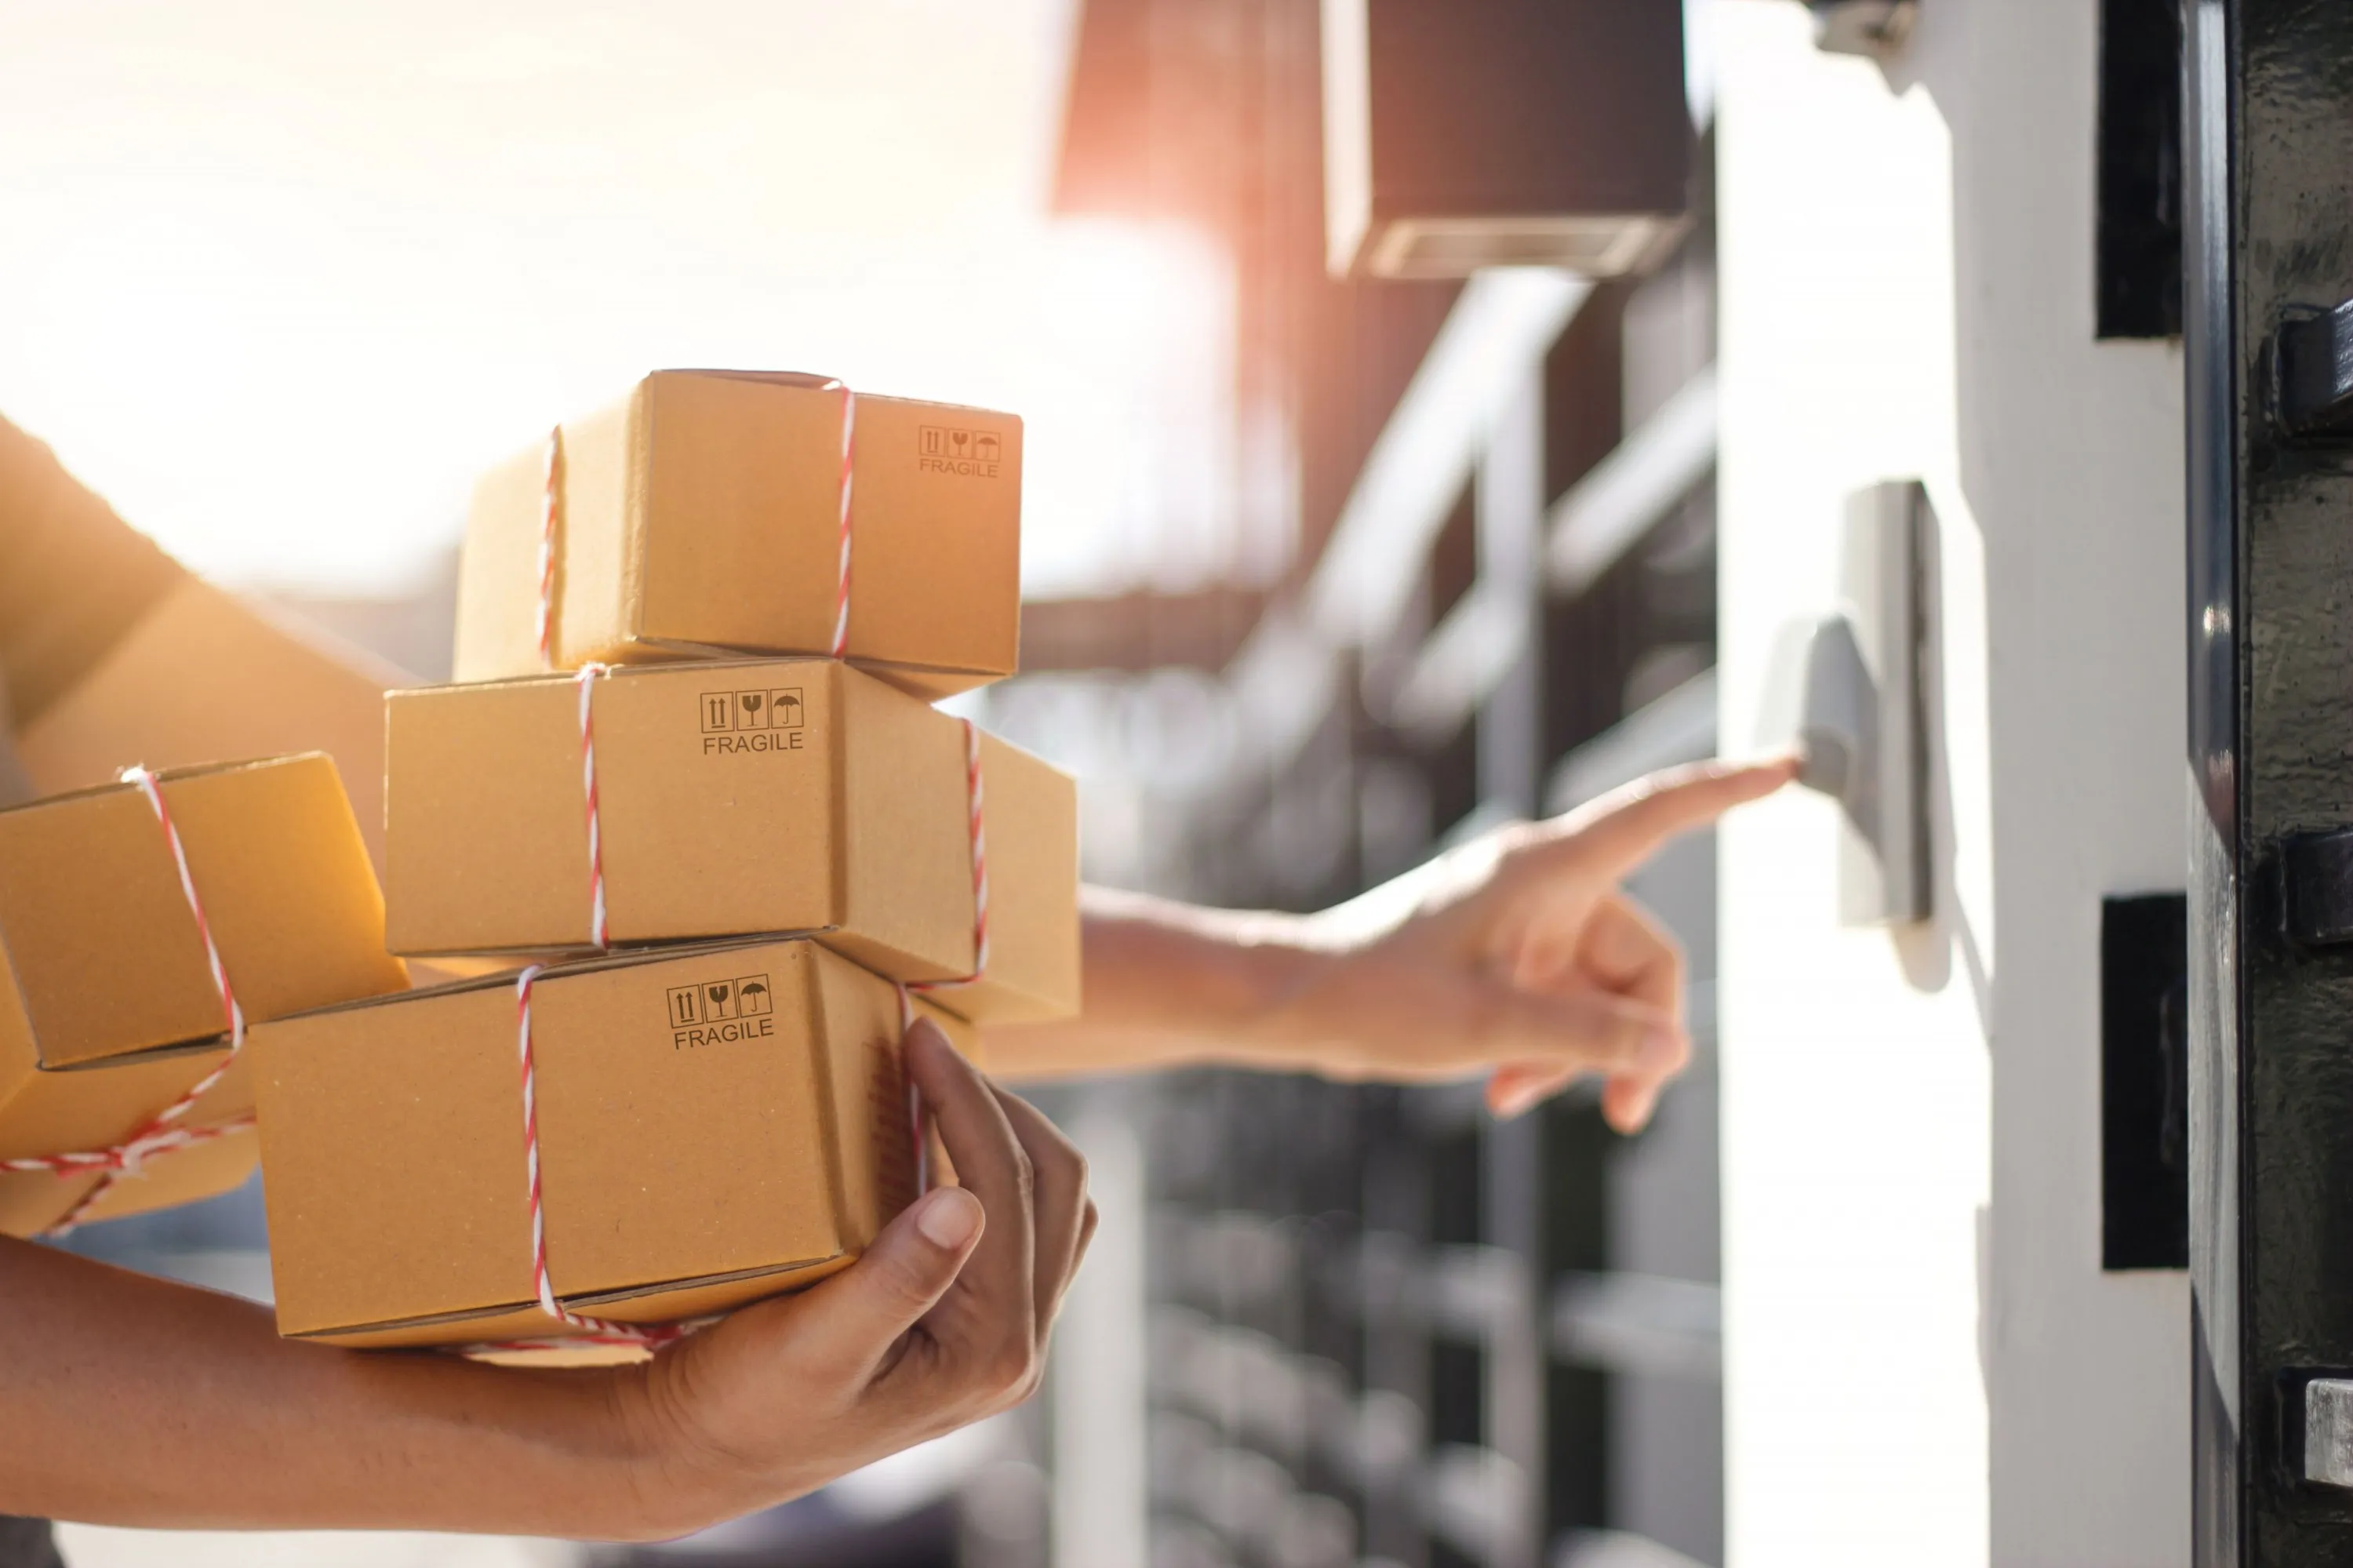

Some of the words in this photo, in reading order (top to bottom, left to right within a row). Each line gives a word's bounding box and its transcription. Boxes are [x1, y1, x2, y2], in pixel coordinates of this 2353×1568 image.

[919, 458, 998, 478] FRAGILE
[704, 732, 803, 755] FRAGILE
[675, 1018, 774, 1050] FRAGILE
